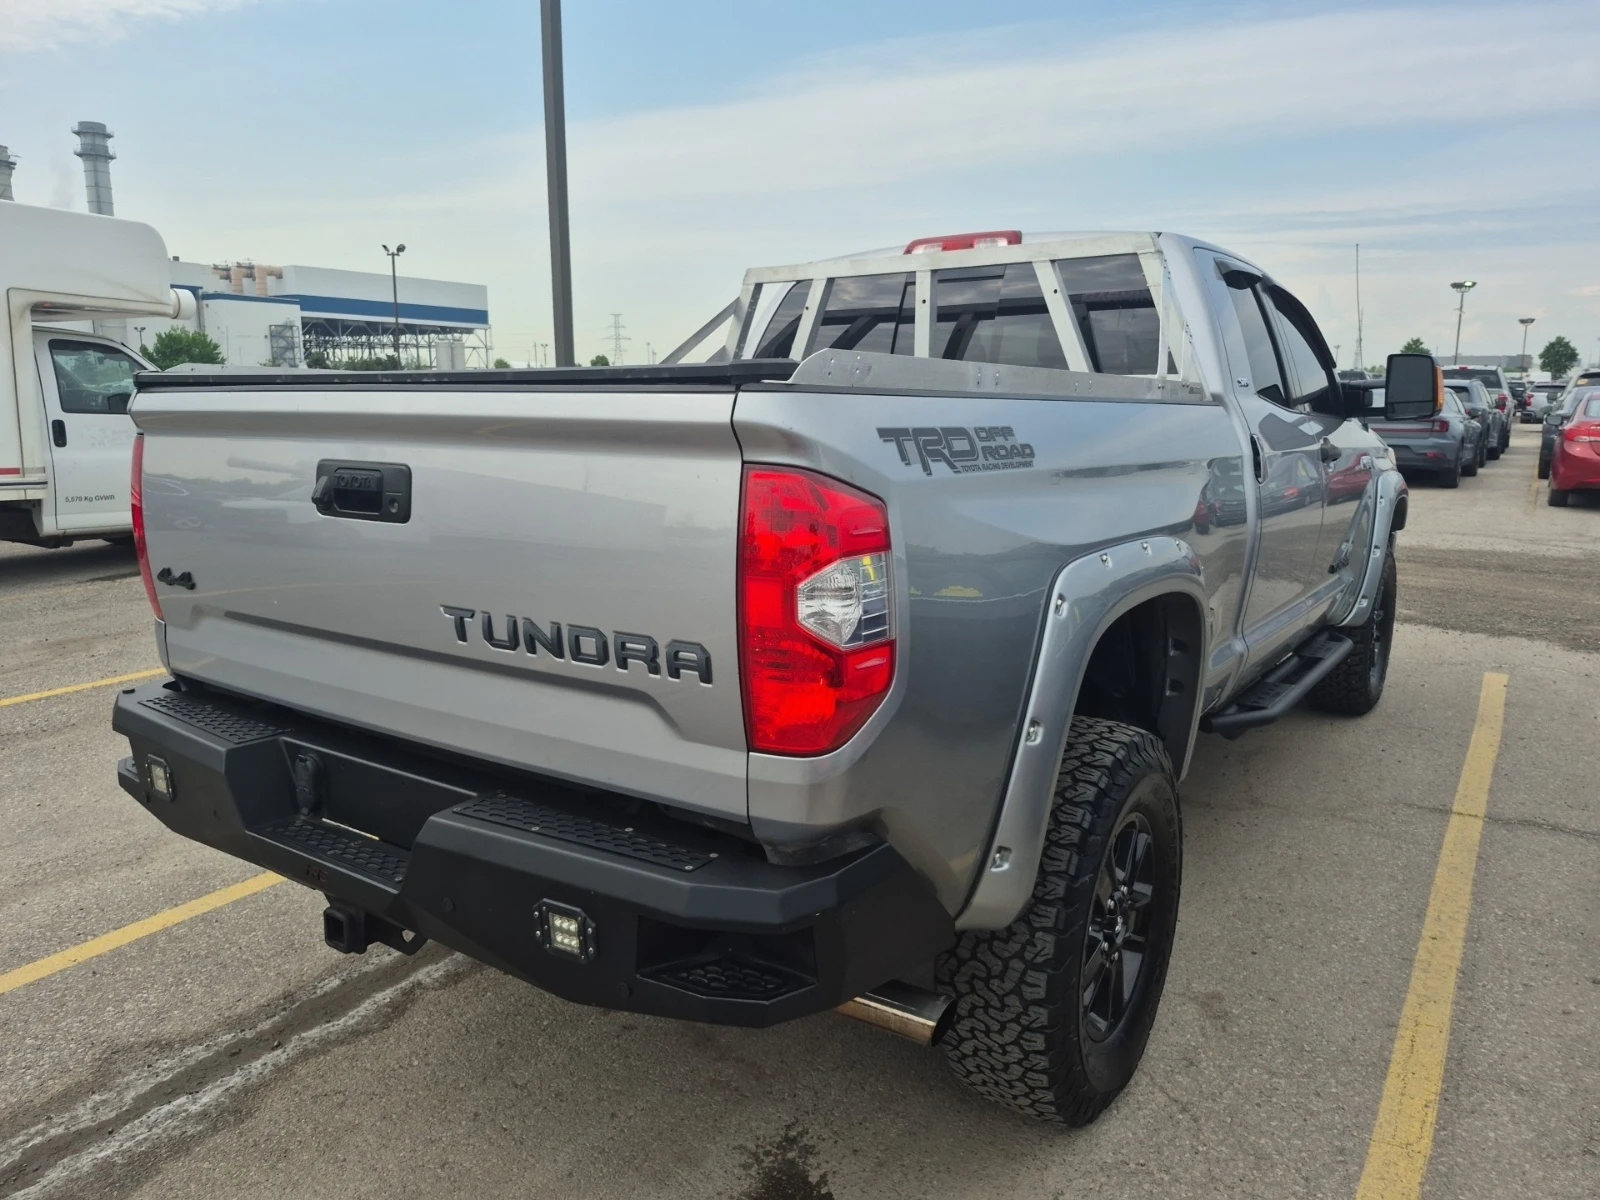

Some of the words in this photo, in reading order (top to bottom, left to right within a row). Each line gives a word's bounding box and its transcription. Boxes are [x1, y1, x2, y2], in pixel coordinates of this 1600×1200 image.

[973, 426, 1015, 442] OFF
[876, 426, 979, 476] TRD
[980, 443, 1036, 461] ROAD
[960, 464, 982, 473] TOYOTA
[982, 462, 1001, 471] RACING
[1000, 460, 1034, 470] DEVELOPMENT
[334, 474, 374, 488] TOYOTA
[84, 495, 94, 503] Kg
[94, 494, 116, 502] GVWR
[440, 604, 713, 687] TUNDRA
